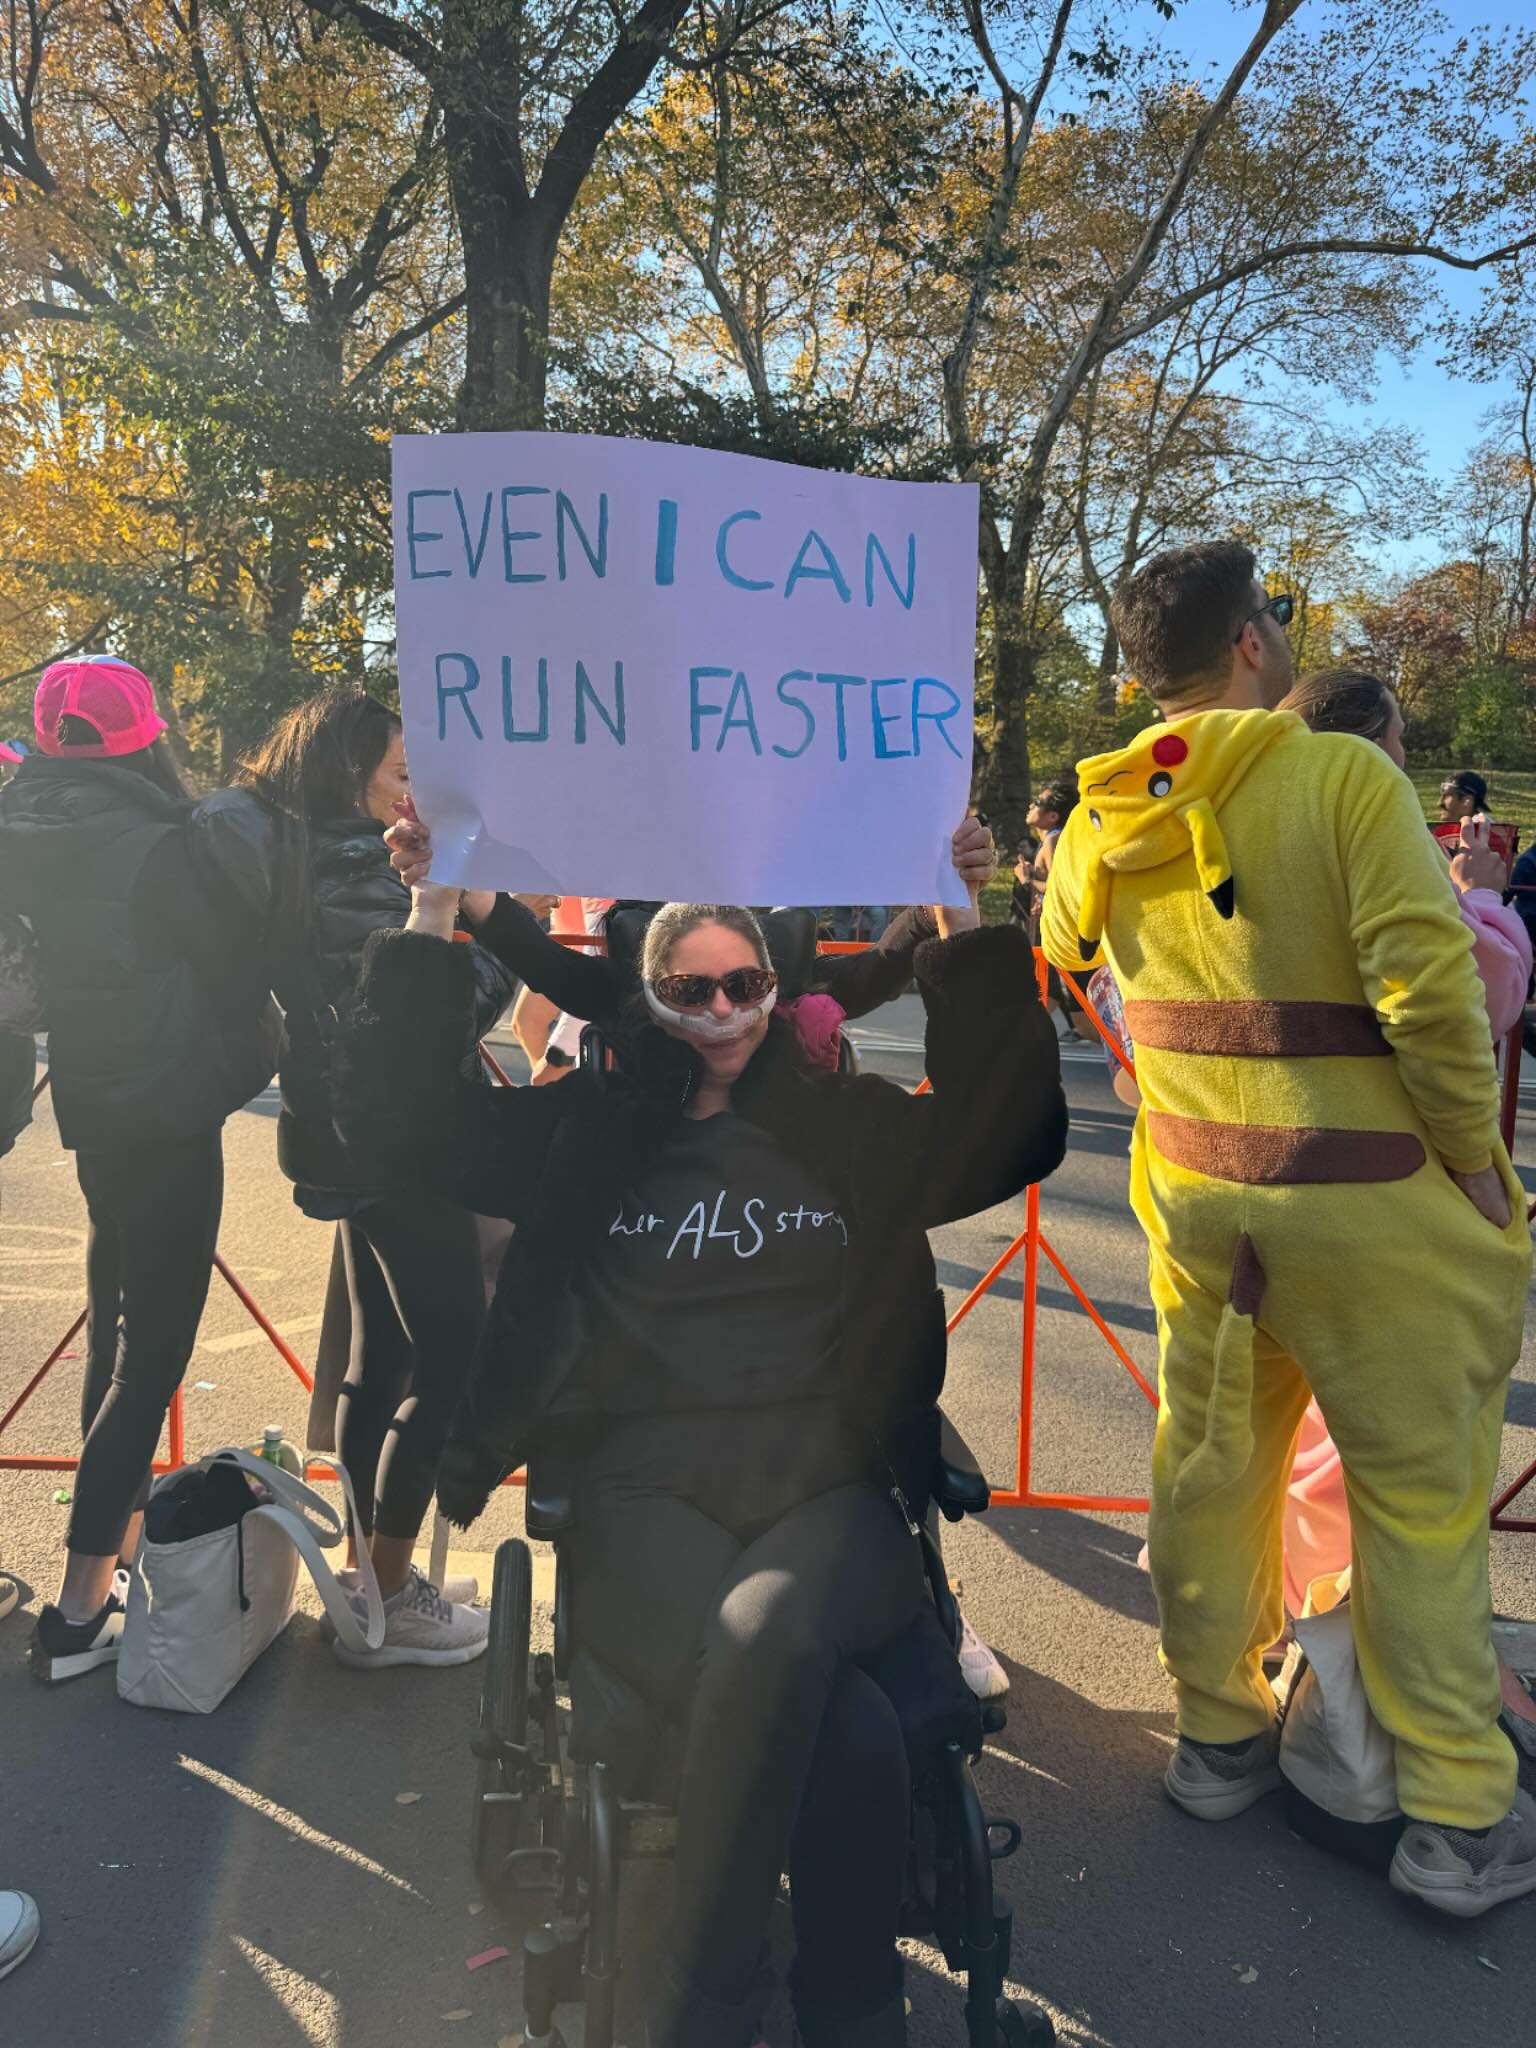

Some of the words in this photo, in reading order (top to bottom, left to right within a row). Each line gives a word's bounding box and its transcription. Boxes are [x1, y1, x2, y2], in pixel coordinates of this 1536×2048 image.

[406, 486, 608, 583] EVEN
[655, 499, 677, 586] I
[716, 510, 916, 610] CAN
[435, 652, 626, 746] RUN
[689, 666, 963, 762] FASTER
[665, 1190, 765, 1260] ALS
